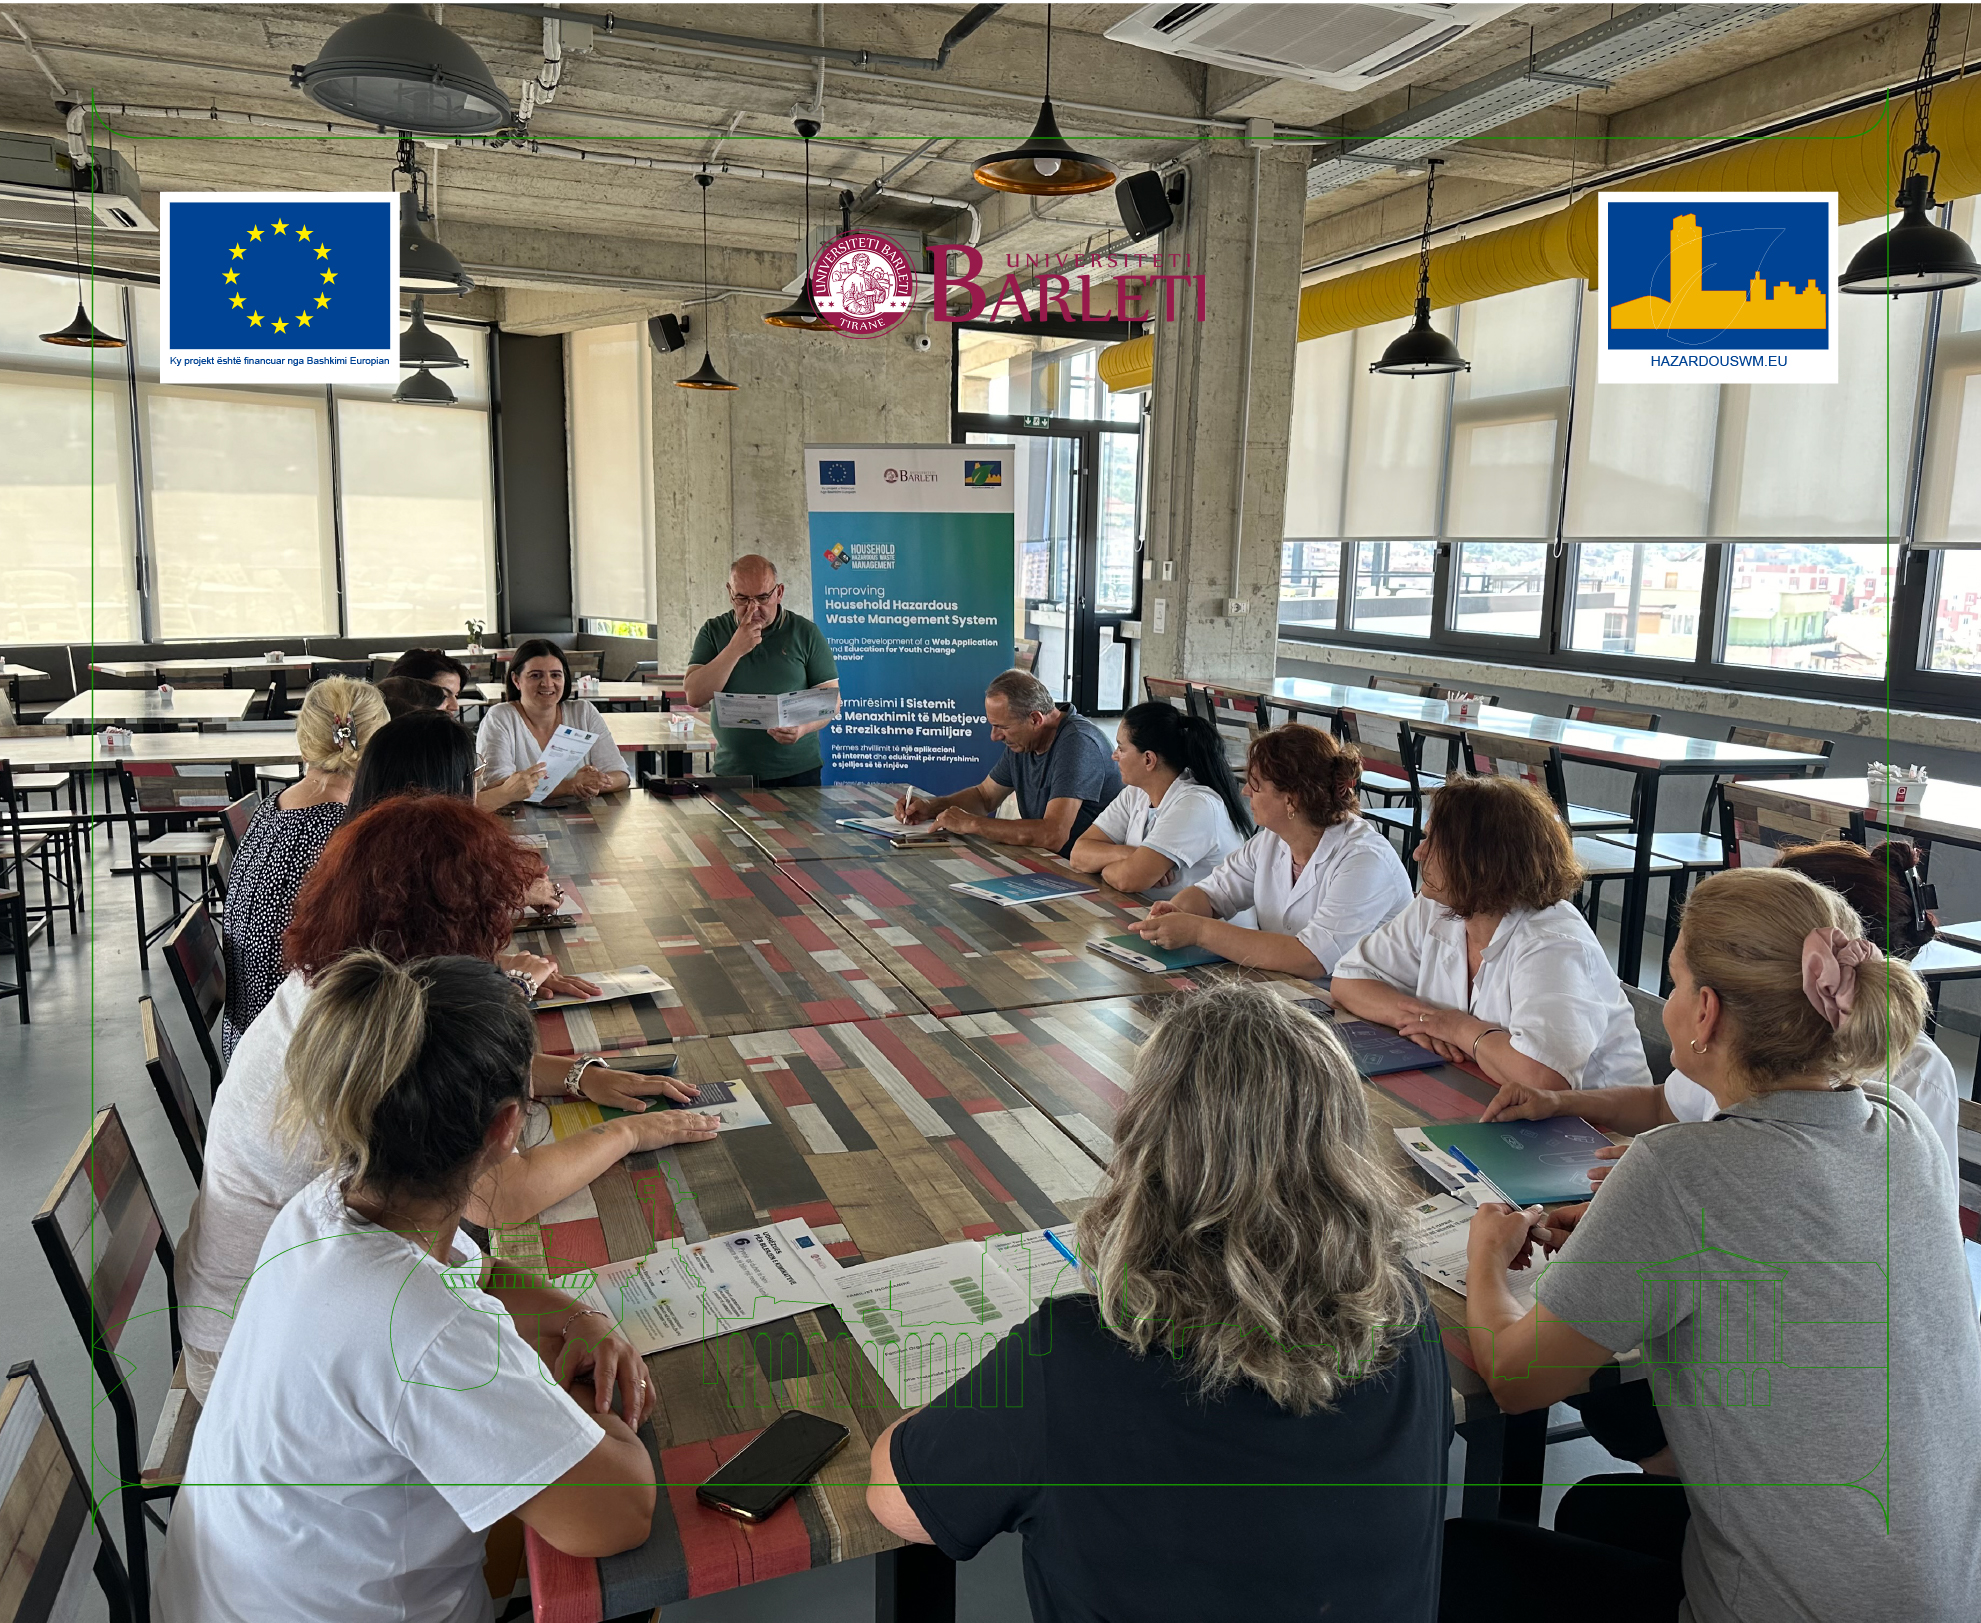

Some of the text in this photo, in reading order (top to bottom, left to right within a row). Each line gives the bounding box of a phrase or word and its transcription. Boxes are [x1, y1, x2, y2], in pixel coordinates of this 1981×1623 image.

[900, 470, 938, 482] BARLETI
[850, 544, 895, 554] HOUSEHOLD
[852, 561, 895, 569] MANAGEMENT
[825, 585, 885, 598] Improving
[826, 600, 958, 610] Household Hazardous
[826, 614, 998, 628] Waste Management System
[827, 638, 859, 646] Through
[862, 638, 913, 647] Development
[952, 638, 998, 648] Application
[924, 647, 956, 656] Change
[906, 698, 956, 709] Sistemit
[845, 712, 915, 722] Menaxhimit
[918, 713, 929, 722] të
[932, 713, 987, 726] Mbetjeve
[831, 724, 972, 738] të Rrezikshme Familjare
[936, 755, 979, 763] ndryshimin
